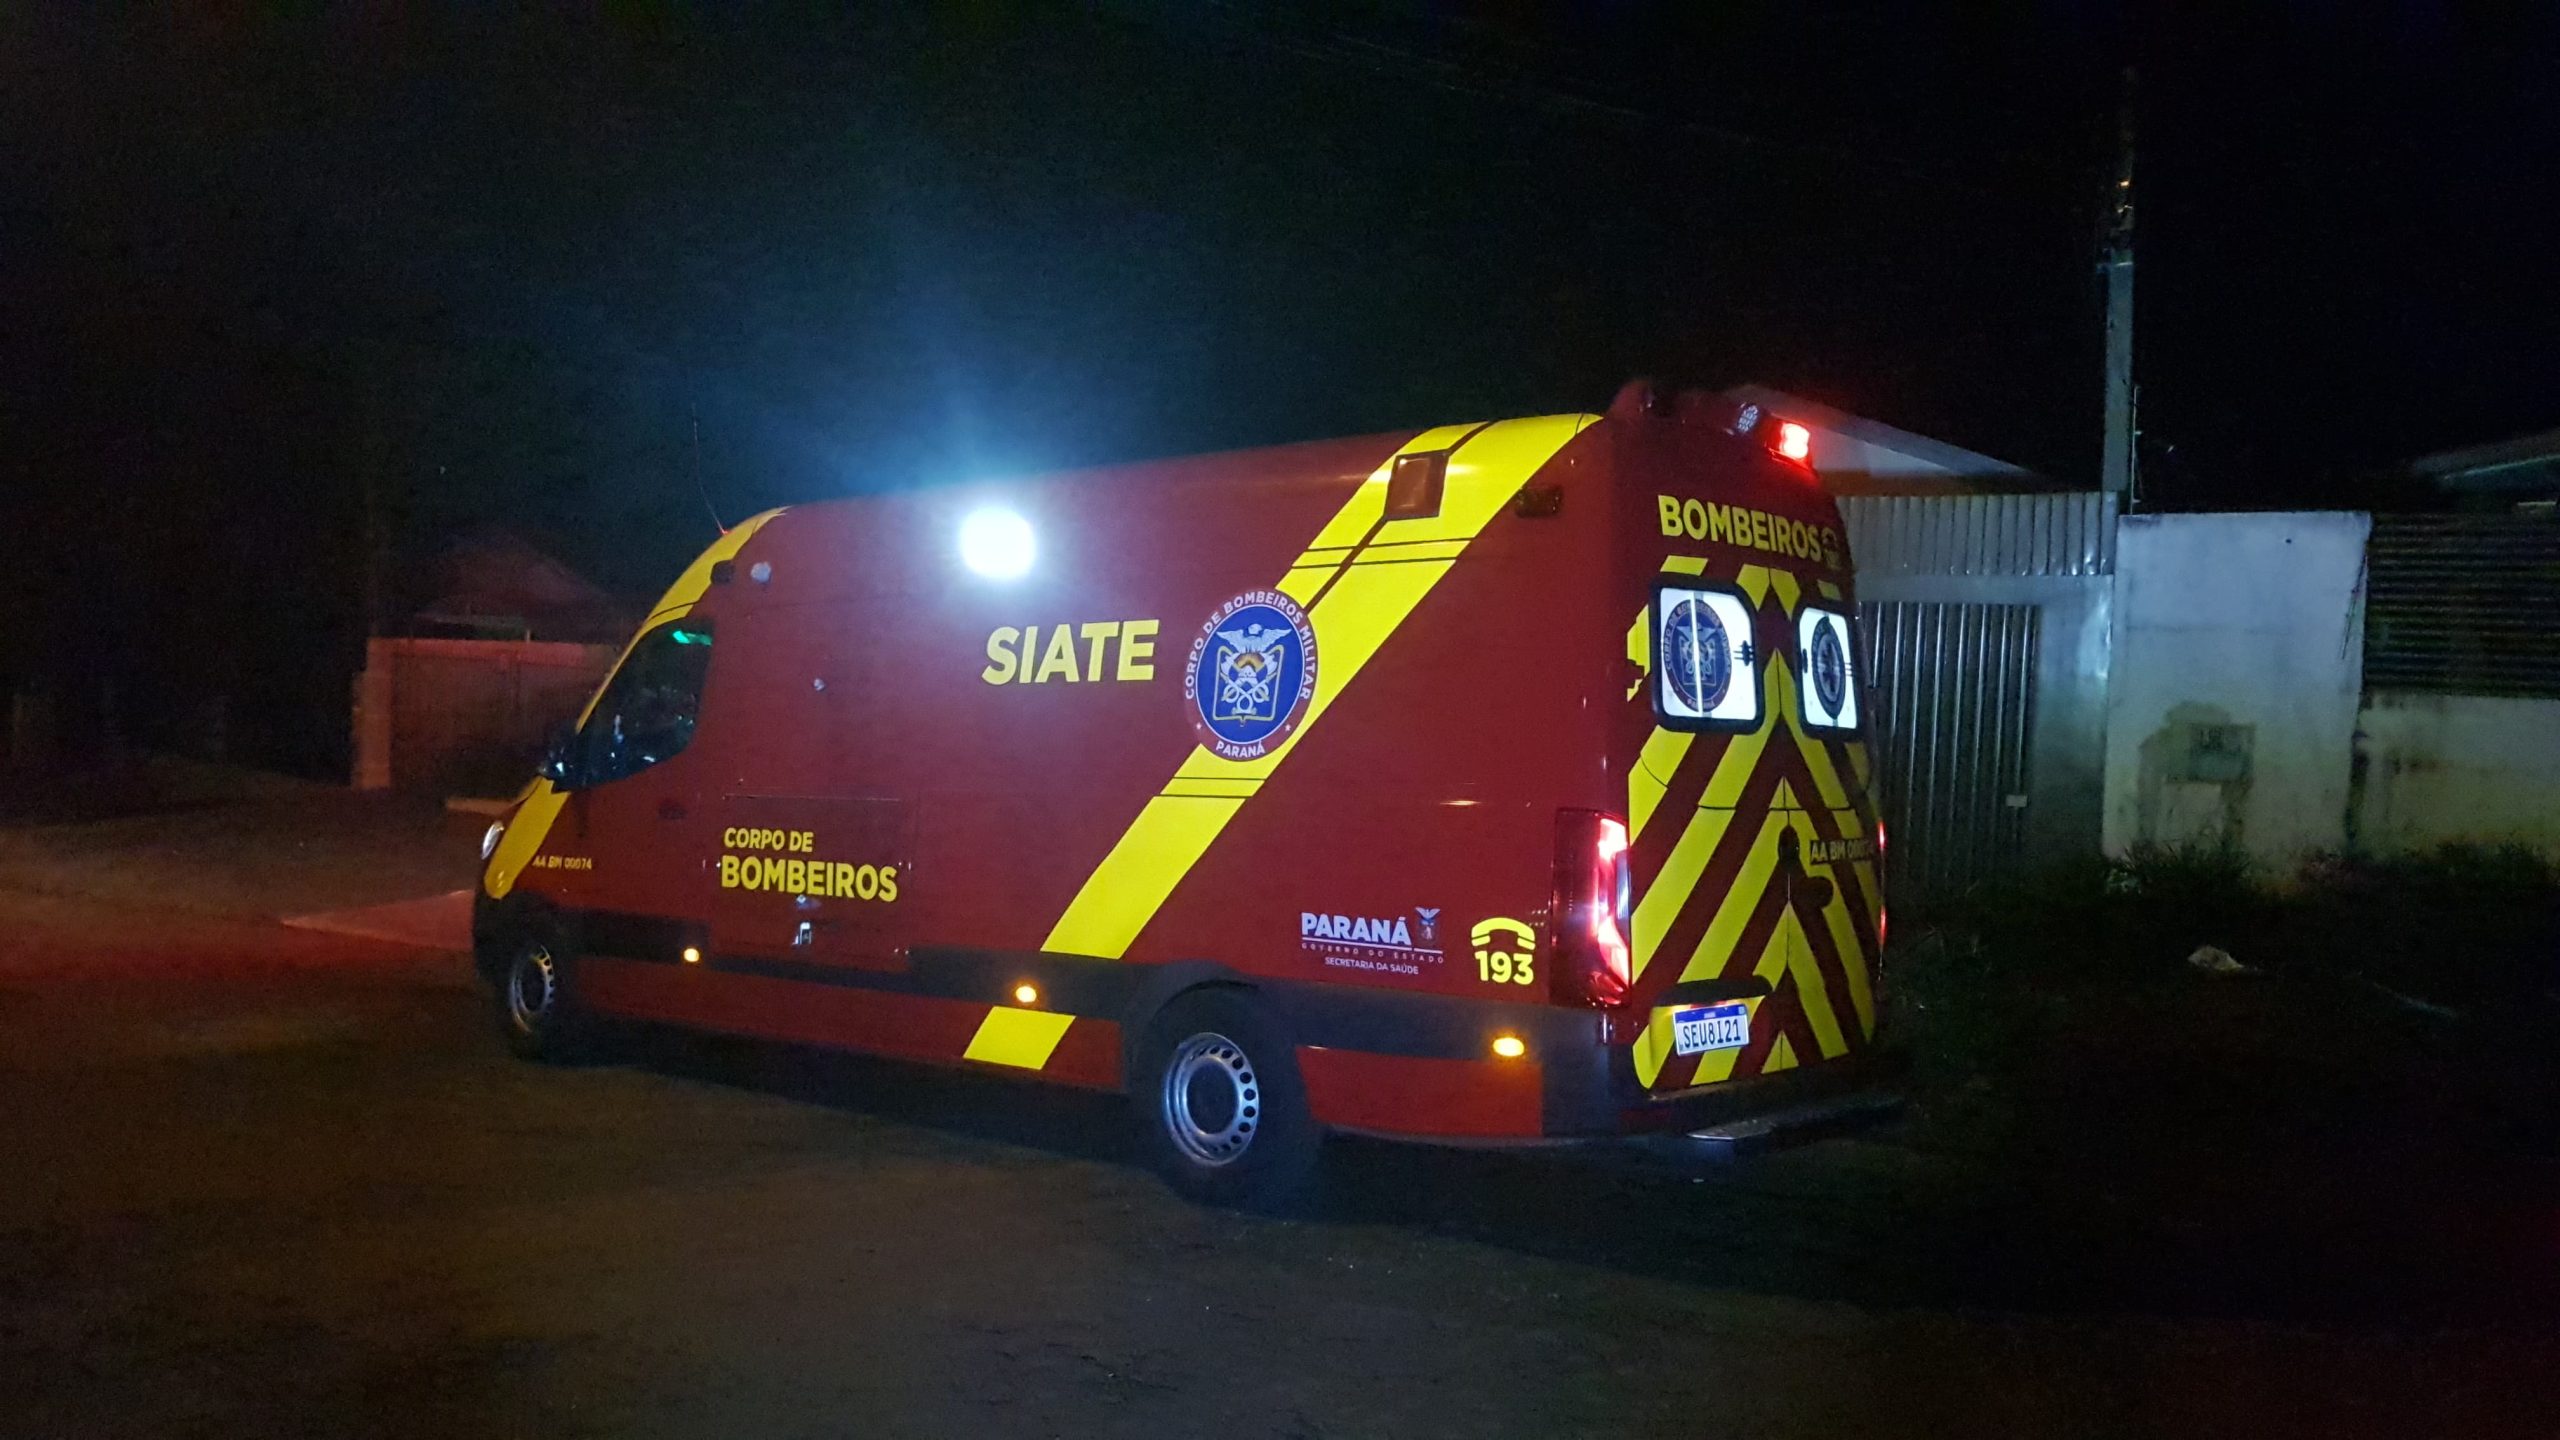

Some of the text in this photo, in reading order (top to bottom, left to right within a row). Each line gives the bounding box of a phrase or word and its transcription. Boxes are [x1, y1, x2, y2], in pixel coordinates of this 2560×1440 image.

[1657, 494, 1822, 563] BOMBEIROS
[980, 618, 1160, 686] SIATE
[1184, 590, 1317, 700] CORPO DE BOMBEIROS MILITAR
[1215, 740, 1266, 758] PARANÁ
[723, 827, 815, 853] CORPO DE
[720, 854, 899, 903] BOMBEIROS
[1300, 911, 1413, 946] PARANÁ
[1301, 942, 1444, 964] GOVERNO DO ESTADO
[1324, 956, 1419, 975] SECRETARIA DA SAÚDE
[1474, 950, 1535, 986] 193
